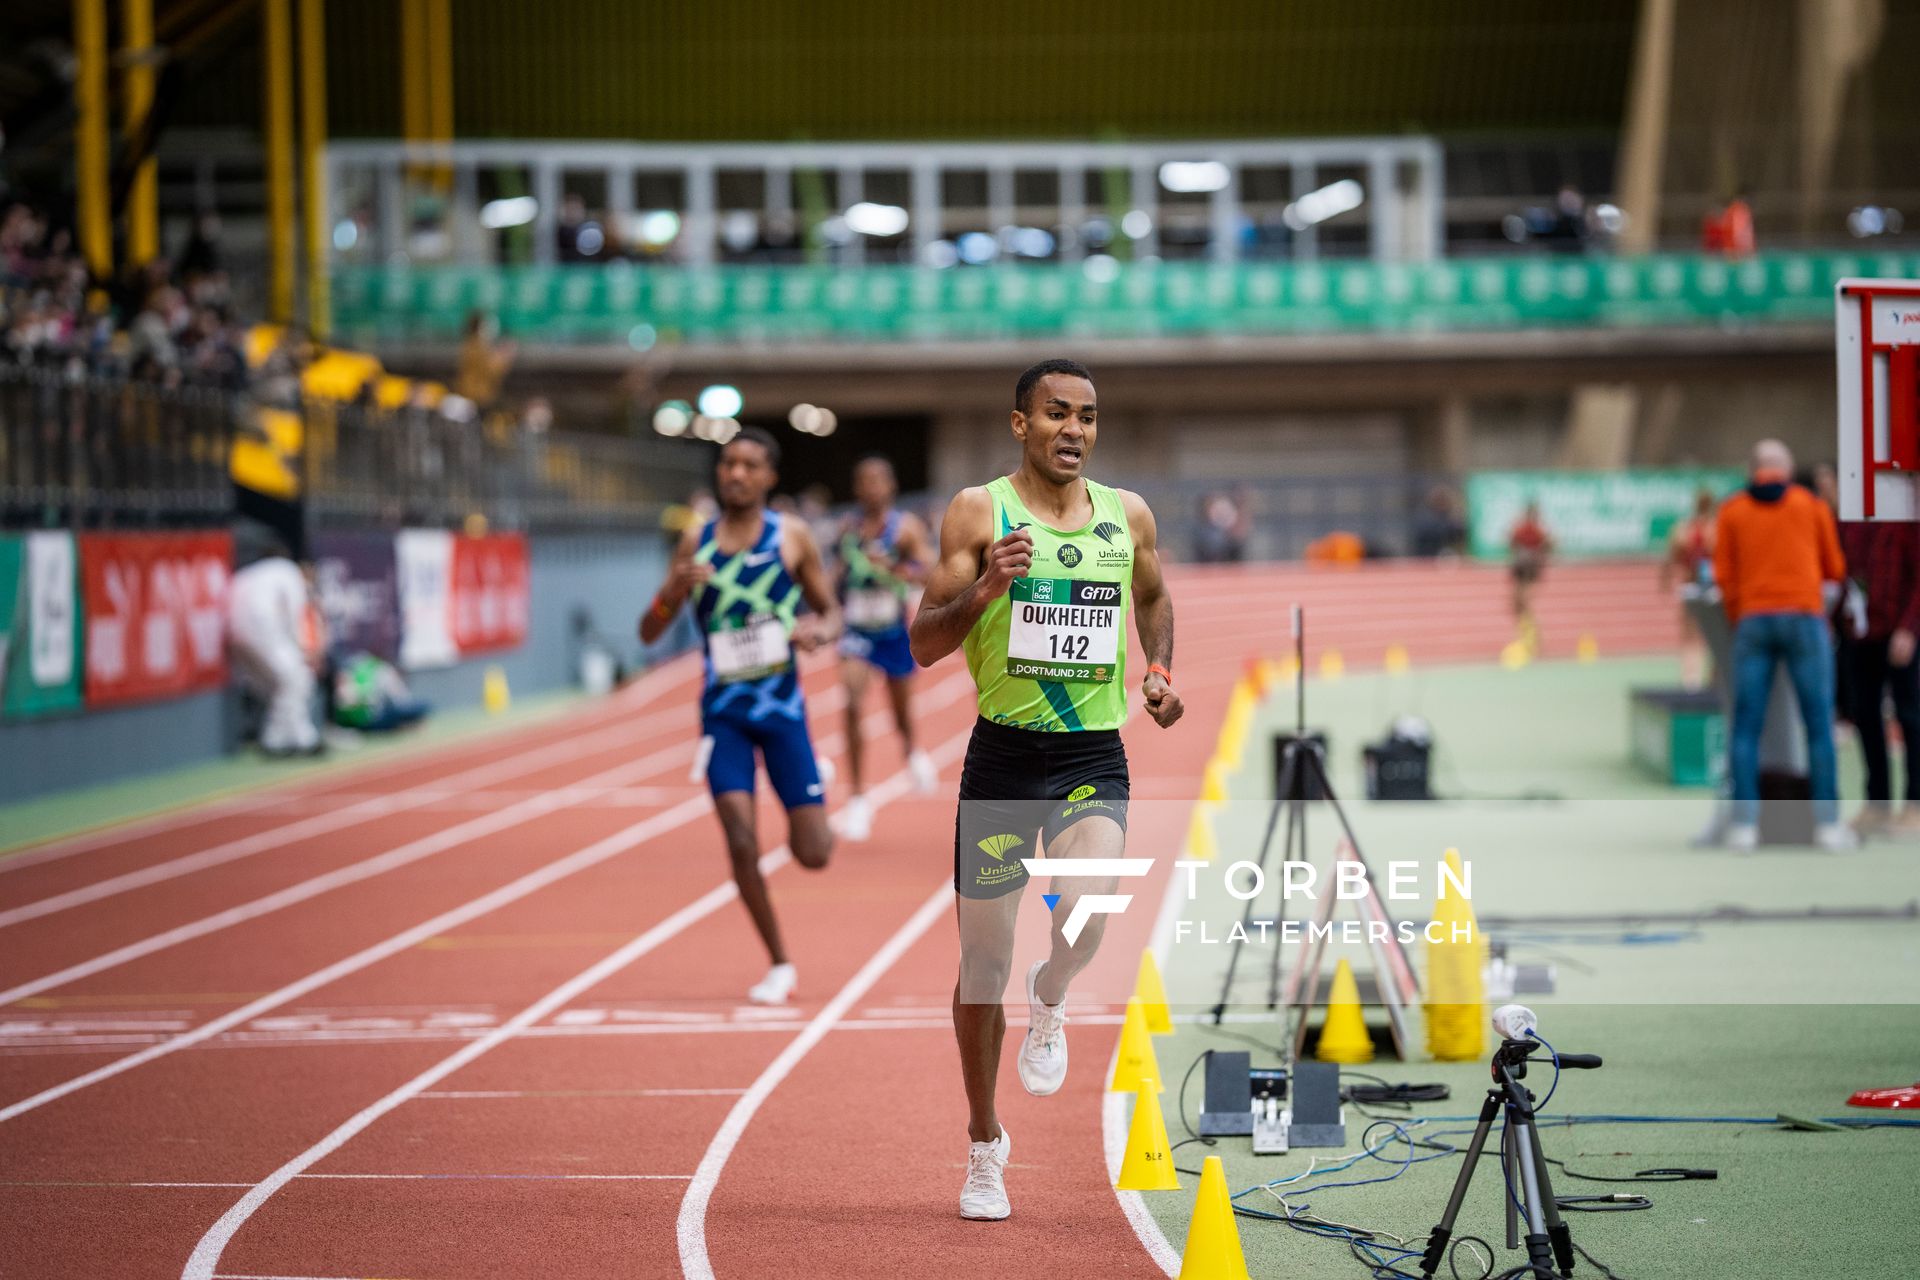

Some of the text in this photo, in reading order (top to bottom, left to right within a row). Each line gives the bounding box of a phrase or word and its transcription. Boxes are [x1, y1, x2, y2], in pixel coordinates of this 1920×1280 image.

[1099, 549, 1129, 560] Unicaja
[1034, 592, 1051, 600] Bank
[1081, 586, 1115, 600] GfTD
[1022, 604, 1113, 628] OUKHELFEN
[1049, 634, 1090, 660] 142
[1016, 664, 1090, 678] DORTMUND 22
[981, 861, 1021, 876] Unicaja
